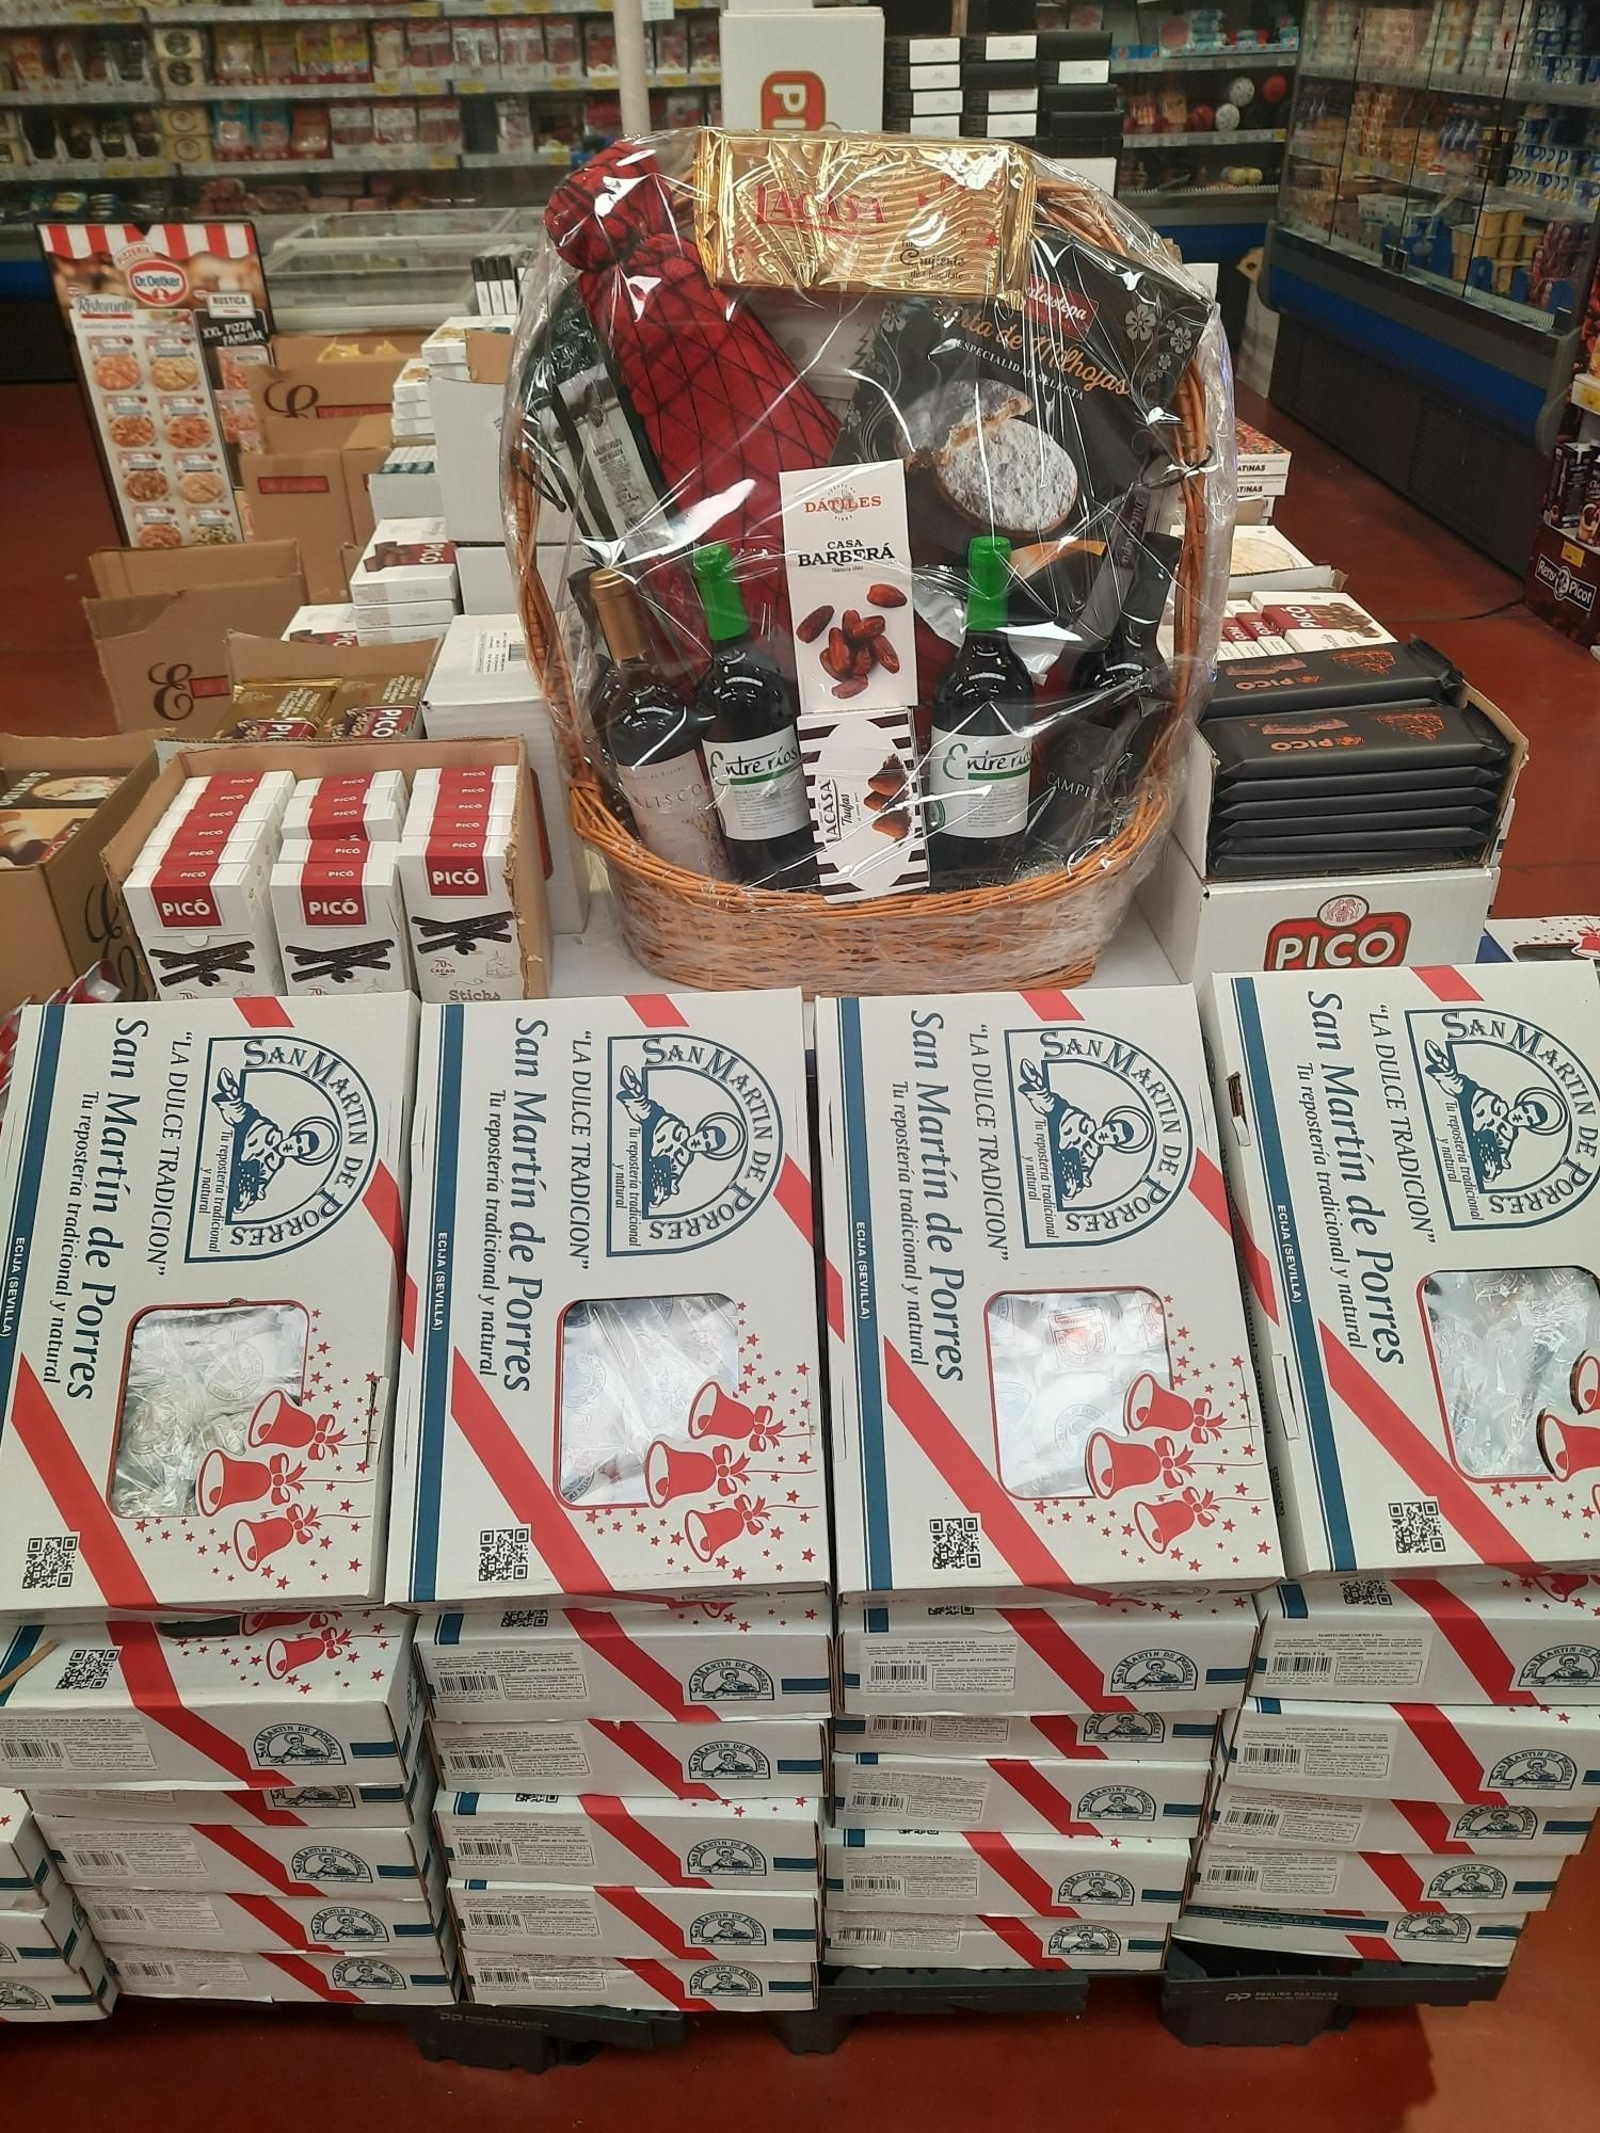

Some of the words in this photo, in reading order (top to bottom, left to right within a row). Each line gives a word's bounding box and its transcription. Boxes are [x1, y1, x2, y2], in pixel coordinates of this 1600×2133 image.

[78, 297, 134, 314] Ristorante
[996, 324, 1023, 350] de
[957, 339, 1035, 379] ESPECIALIDAD
[804, 496, 882, 512] DÁTILES
[419, 544, 444, 564] PICÓ
[798, 542, 896, 567] BARBERÁ
[827, 540, 864, 549] CASA
[1538, 560, 1556, 582] Reny
[1569, 580, 1593, 604] Picot
[1280, 606, 1322, 628] PICÓ
[841, 794, 854, 826] Trufas
[432, 868, 479, 885] PICÓ
[162, 899, 210, 916] PICÓ
[309, 899, 358, 916] PICÓ
[449, 990, 501, 1000] Sticks
[910, 1010, 944, 1069] San
[1307, 990, 1342, 1050] San
[1441, 1012, 1506, 1039] SAN
[110, 1017, 149, 1078] San
[244, 1040, 307, 1067] SAN
[514, 1017, 548, 1077] San
[642, 1038, 705, 1065] SAN
[1040, 1031, 1103, 1058] SAN
[892, 1081, 908, 1098] Tu
[1103, 1042, 1181, 1134] MARTIN
[1296, 1062, 1314, 1080] Tu
[1507, 1023, 1596, 1116] MARTIN
[81, 1091, 99, 1109] Tu
[302, 1051, 367, 1145] MARTIN
[489, 1089, 506, 1107] Tu
[702, 1048, 772, 1139] MARTIN
[1445, 1100, 1458, 1112] Tu
[220, 1130, 233, 1141] Tu
[628, 1126, 641, 1137] Tu
[890, 1104, 915, 1183] repostería
[915, 1082, 958, 1199] Martín
[1034, 1119, 1047, 1131] Tu
[1298, 1086, 1330, 1165] repostería
[1320, 1063, 1374, 1181] Martín
[1447, 1115, 1470, 1163] repostería
[1575, 1126, 1599, 1158] DE
[69, 1115, 91, 1196] repostería
[92, 1091, 140, 1212] Martín
[215, 1144, 228, 1194] repostería
[484, 1113, 504, 1192] repostería
[510, 1090, 547, 1208] Martín
[625, 1140, 641, 1189] repostería
[744, 1151, 771, 1183] DE
[1033, 1133, 1052, 1181] repostería
[1158, 1144, 1181, 1177] DE
[1441, 1146, 1462, 1183] natural
[335, 1156, 363, 1188] DE
[615, 1172, 627, 1209] natural
[1025, 1164, 1041, 1201] natural
[1459, 1166, 1482, 1220] tradicional
[1489, 1156, 1592, 1214] PORRES
[198, 1176, 211, 1214] natural
[231, 1187, 344, 1246] PORRES
[649, 1182, 757, 1240] PORRES
[1041, 1184, 1059, 1238] tradicional
[1066, 1173, 1171, 1232] PORRES
[1345, 1195, 1386, 1235] de
[208, 1197, 225, 1253] tradicional
[628, 1192, 641, 1246] tradicional
[899, 1188, 922, 1280] tradicional
[925, 1212, 963, 1253] de
[1277, 1204, 1291, 1240] ECIJA
[1316, 1171, 1350, 1263] tradicional
[11, 1237, 25, 1273] ECIJA
[55, 1202, 81, 1296] tradicional
[85, 1226, 124, 1268] de
[436, 1232, 447, 1267] ECIJA
[482, 1198, 502, 1290] tradicional
[508, 1221, 546, 1262] de
[856, 1222, 866, 1256] ECIJA
[856, 1260, 870, 1319] (SEVILLA)
[900, 1283, 918, 1295] y
[1281, 1243, 1302, 1303] (SEVILLA)
[1329, 1266, 1348, 1278] y
[0, 1276, 19, 1337] (SEVILLA)
[49, 1300, 66, 1311] y
[431, 1270, 445, 1330] (SEVILLA)
[477, 1294, 494, 1305] y
[1337, 1283, 1365, 1347] natural
[1355, 1248, 1404, 1364] Porres
[66, 1281, 116, 1399] Porres
[479, 1311, 497, 1376] natural
[503, 1275, 542, 1391] Porres
[906, 1300, 929, 1364] natural
[929, 1265, 964, 1381] Porres
[43, 1317, 63, 1383] natural
